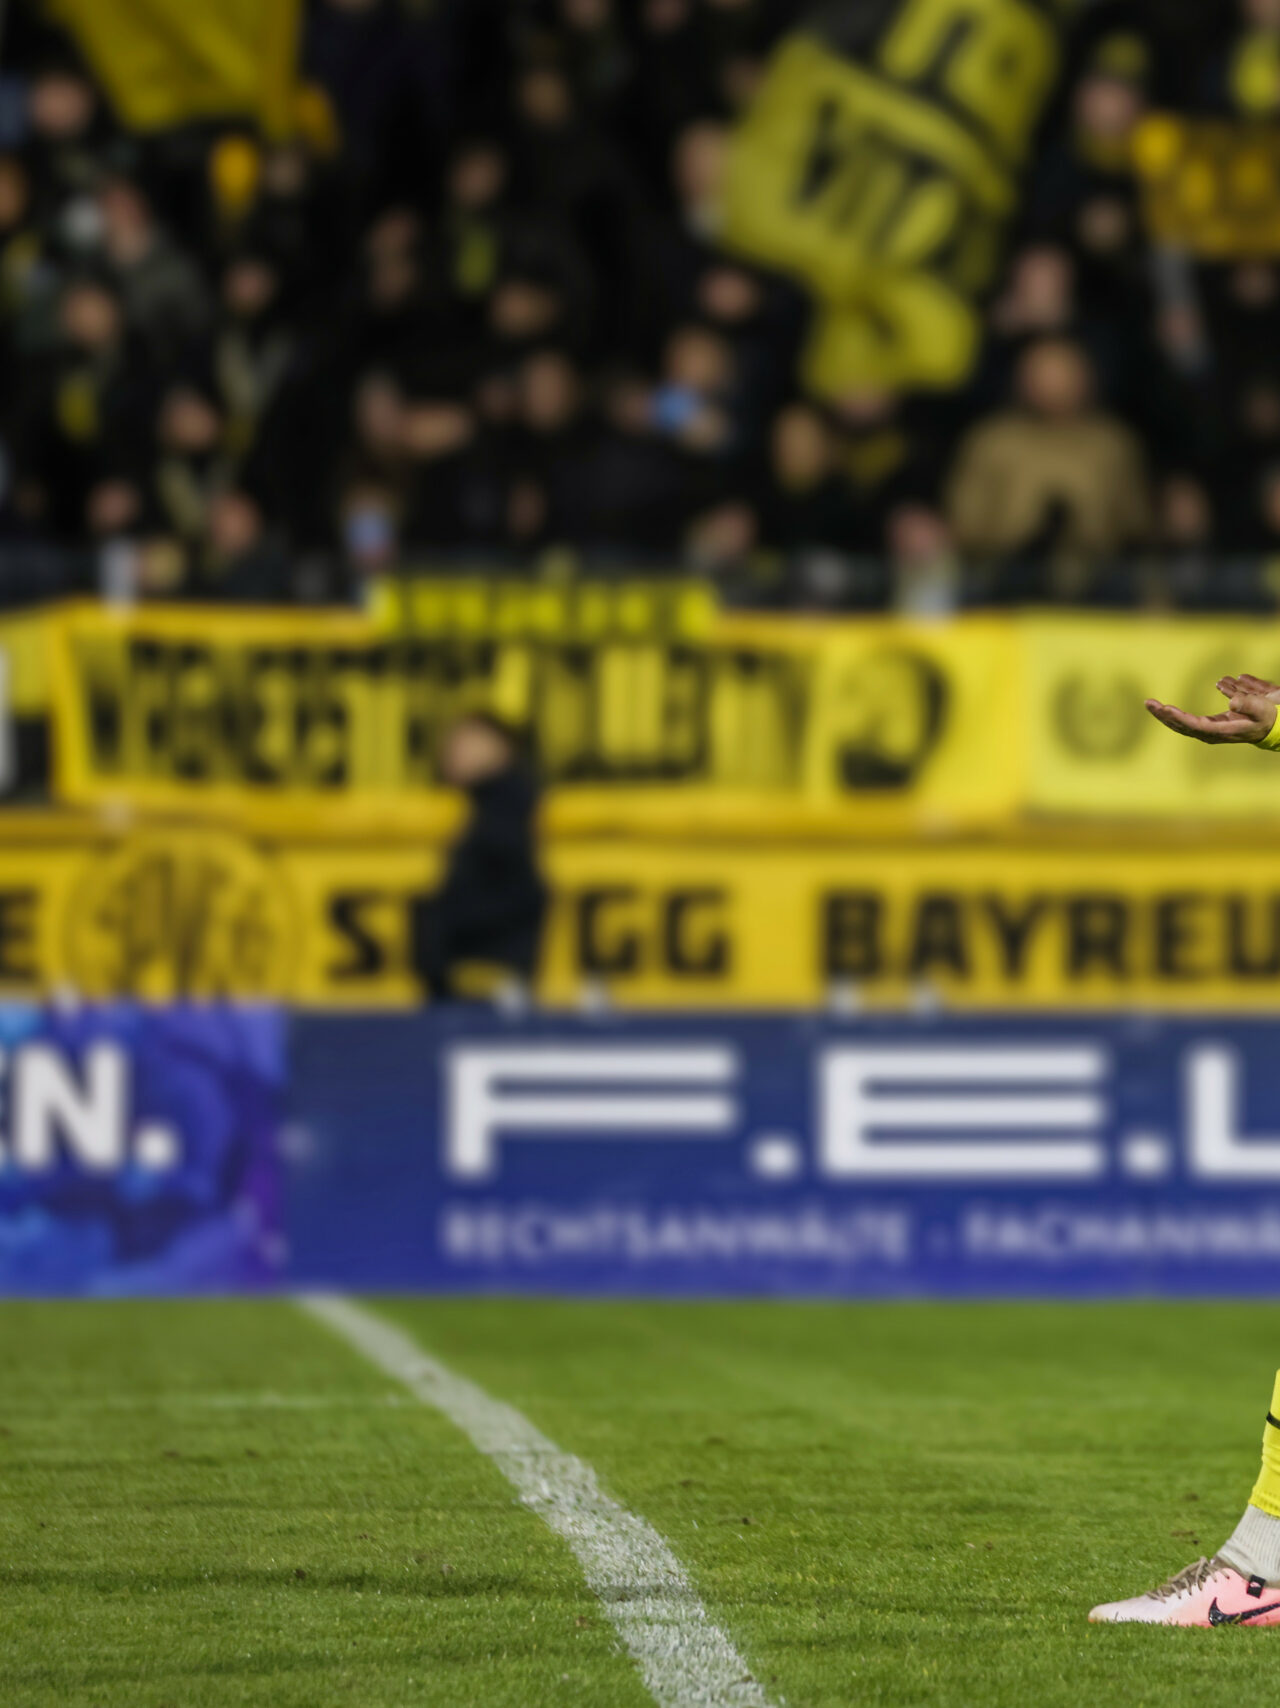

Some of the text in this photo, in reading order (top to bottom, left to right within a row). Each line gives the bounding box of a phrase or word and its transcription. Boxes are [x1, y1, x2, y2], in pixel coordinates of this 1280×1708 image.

[326, 890, 732, 981] SGG
[0, 1042, 178, 1172] N.
[442, 1205, 910, 1265] RECHTSANWÄLTE
